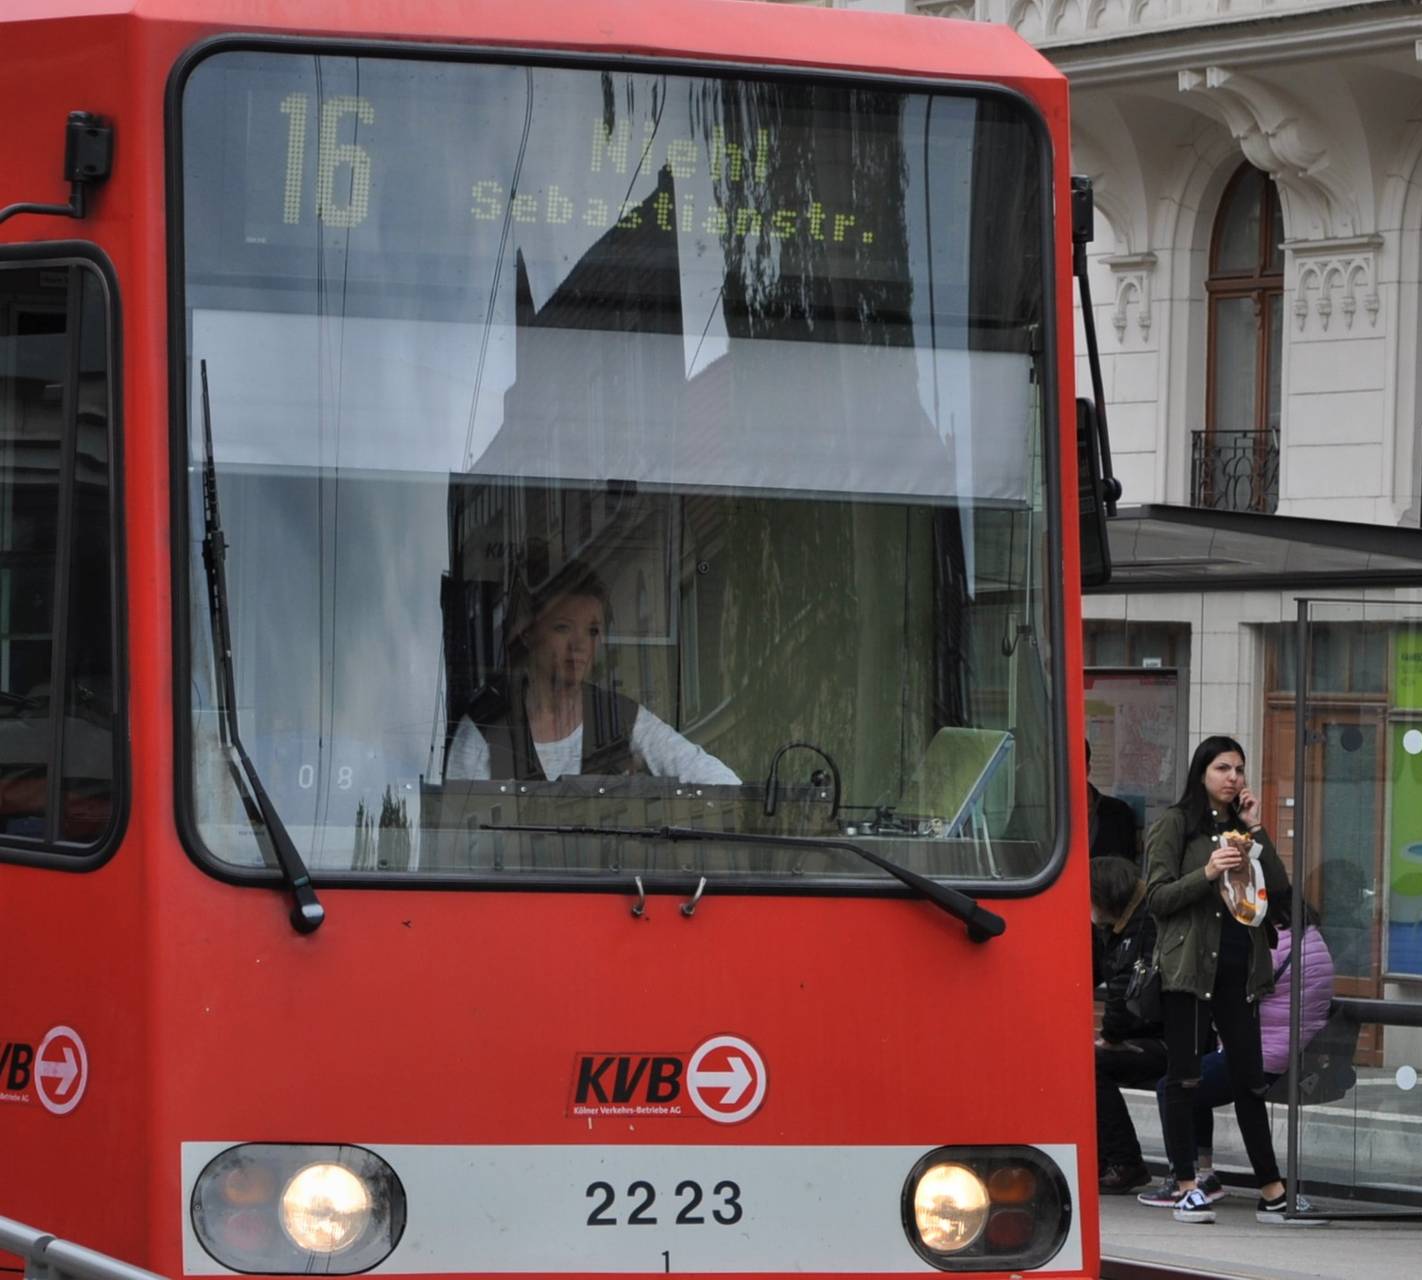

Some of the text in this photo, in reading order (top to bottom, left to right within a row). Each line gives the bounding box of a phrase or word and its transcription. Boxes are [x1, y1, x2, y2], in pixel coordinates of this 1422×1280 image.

[280, 92, 374, 228] 16
[591, 120, 769, 183] Niehl
[471, 181, 873, 244] Sebastianstr.
[574, 1056, 683, 1103] KVB
[573, 1105, 682, 1115] Kölner Verkehrs-Betriebe AG
[661, 1250, 670, 1273] 1
